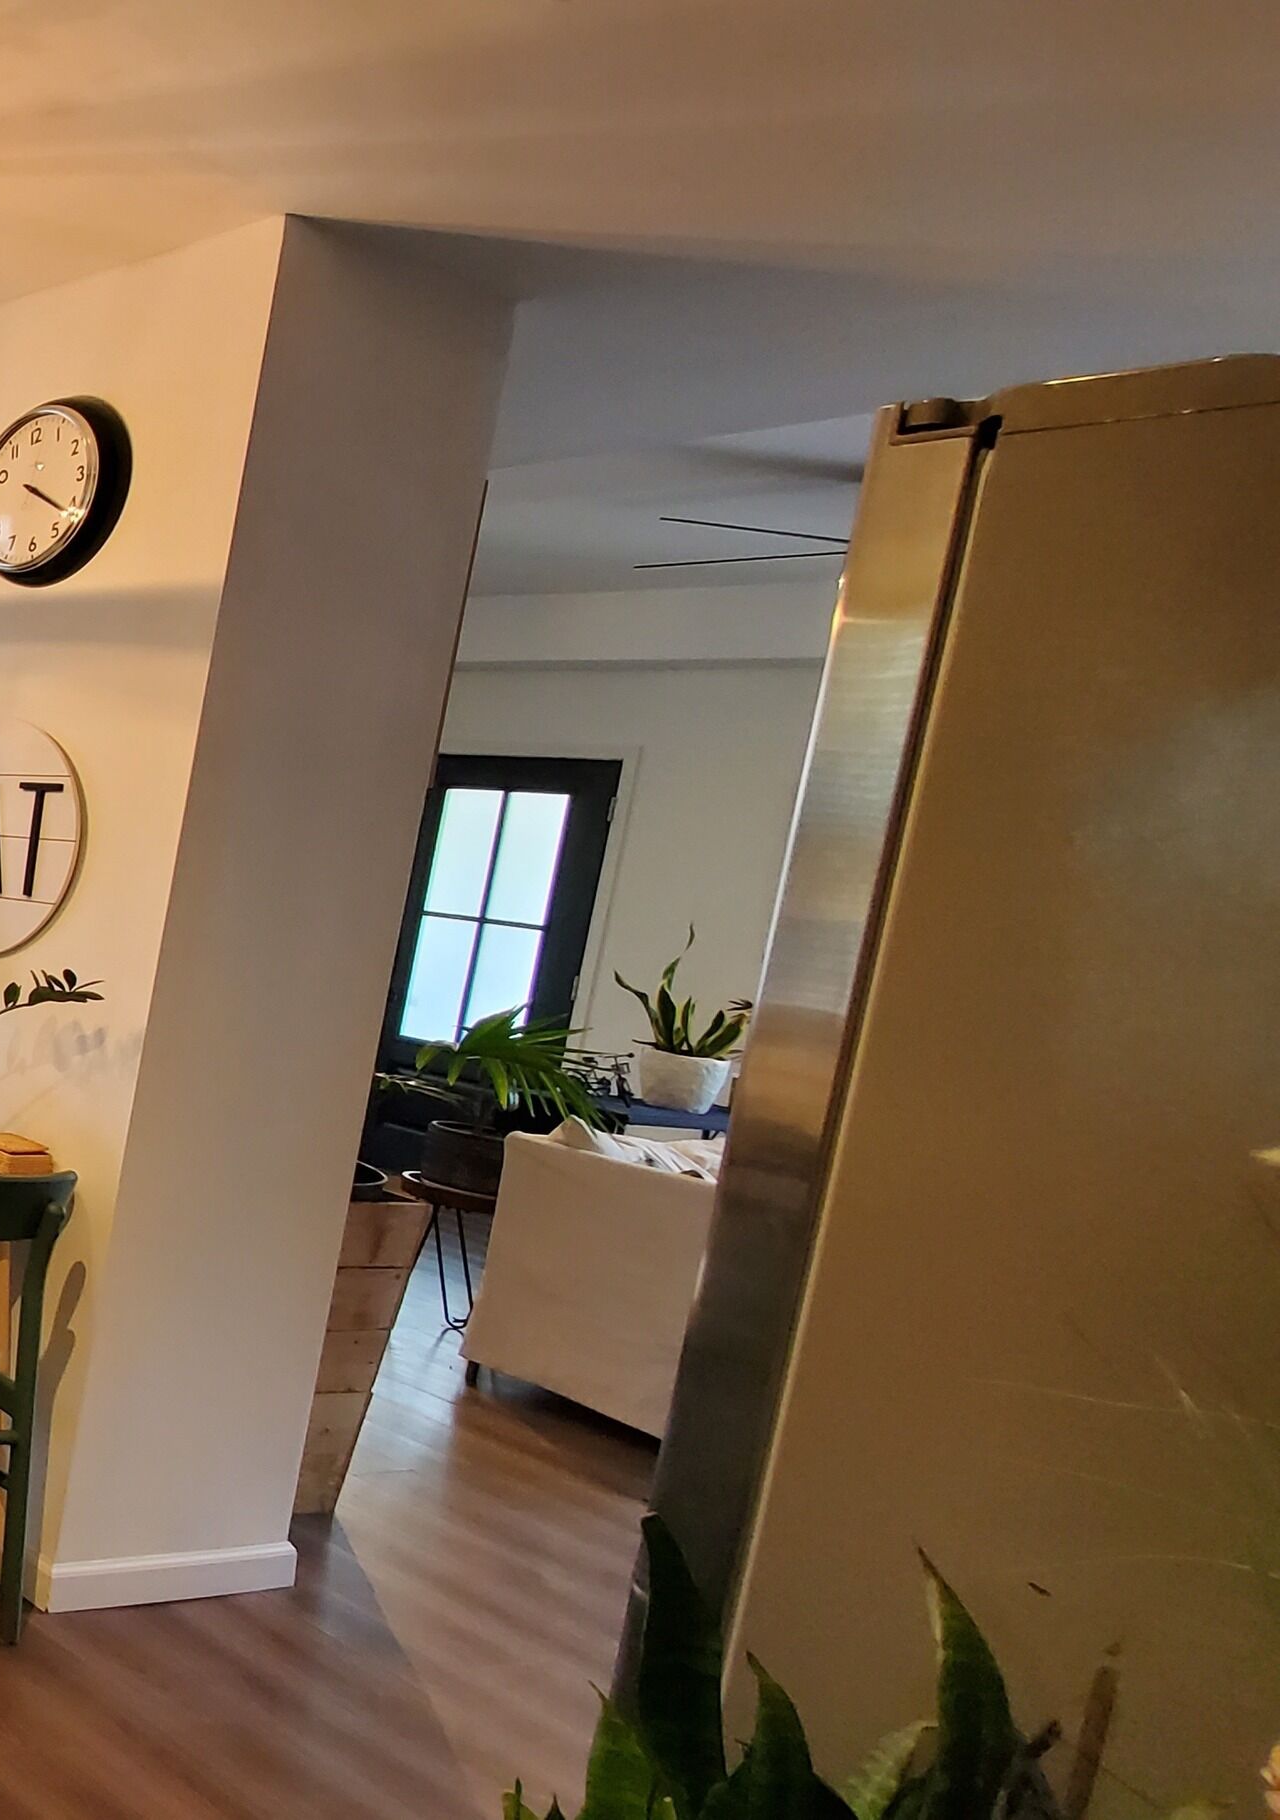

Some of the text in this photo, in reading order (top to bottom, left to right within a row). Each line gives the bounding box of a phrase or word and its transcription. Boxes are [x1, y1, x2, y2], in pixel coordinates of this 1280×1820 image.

[31, 428, 43, 446] 12
[56, 426, 61, 443] 1
[11, 444, 20, 461] 11
[71, 439, 80, 457] 2
[76, 466, 86, 482] 3
[51, 522, 60, 539] 5
[8, 535, 17, 552] 7
[29, 536, 38, 553] 6
